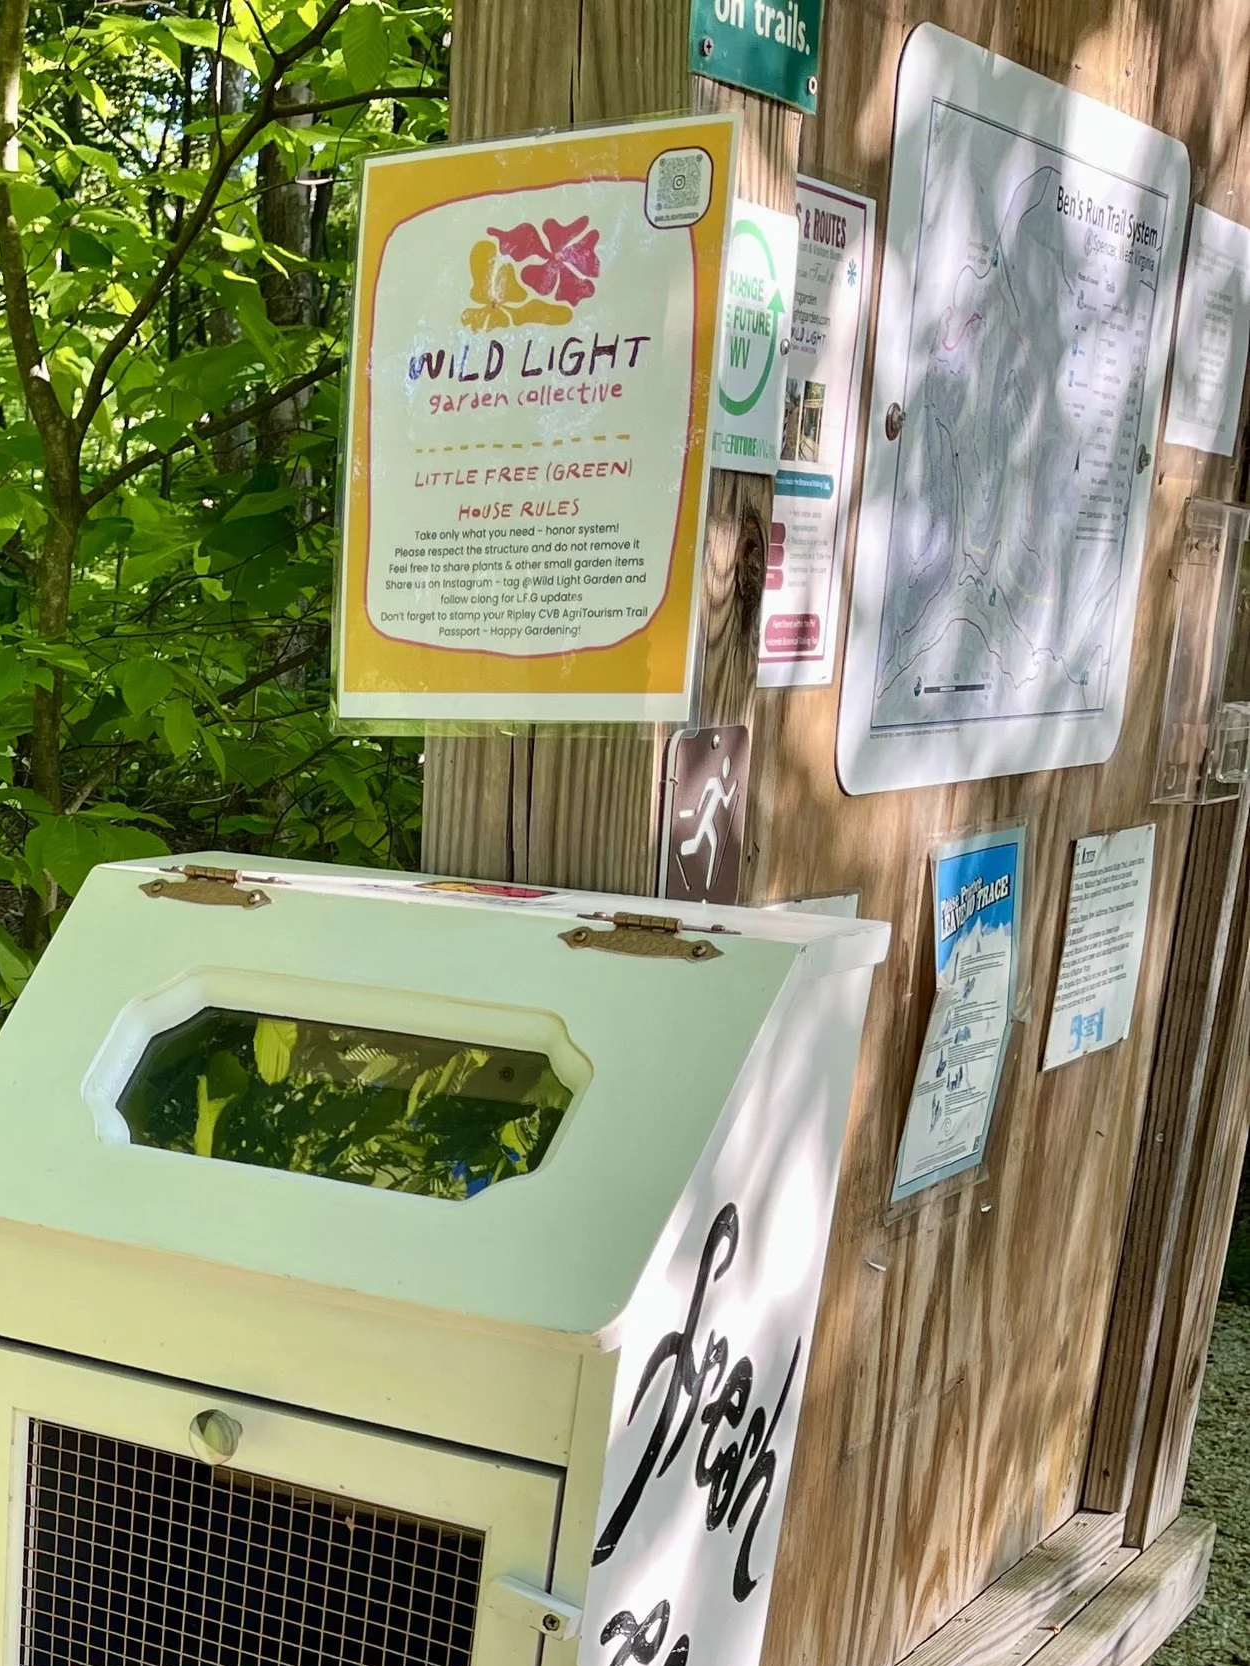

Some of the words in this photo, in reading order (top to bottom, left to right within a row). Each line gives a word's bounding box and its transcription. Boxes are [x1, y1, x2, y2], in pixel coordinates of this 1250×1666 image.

[754, 0, 810, 56] trails.
[813, 207, 847, 250] ROUTES
[1056, 185, 1084, 221] Ben's
[1085, 196, 1105, 228] Run
[1106, 204, 1128, 236] Trail
[1127, 213, 1158, 248] System
[733, 305, 772, 337] FUTURE
[408, 339, 504, 382] WILD
[520, 332, 651, 378] LIGHT
[730, 335, 751, 370] WV
[429, 391, 509, 415] garden
[517, 380, 623, 406] collective
[415, 468, 478, 488] LITTLE
[485, 466, 539, 485] FREE
[546, 457, 633, 482] (GREEN)
[458, 503, 513, 521] HOUSE
[520, 498, 580, 518] RULES
[414, 529, 437, 541] Take
[439, 529, 460, 541] only
[462, 528, 487, 539] what
[488, 529, 507, 541] you
[509, 526, 535, 537] need
[545, 525, 575, 535] honor
[578, 523, 620, 537] system!
[394, 547, 425, 557] Please
[428, 545, 464, 558] respect
[466, 545, 482, 555] the
[485, 543, 529, 554] structure
[531, 542, 552, 553] and
[554, 541, 568, 552] do
[570, 541, 588, 551] not
[590, 540, 631, 551] remove
[633, 538, 640, 549] it
[388, 563, 408, 573] Feel
[410, 562, 428, 573] free
[431, 562, 441, 572] to
[443, 562, 470, 572] share
[472, 561, 503, 573] plants
[504, 560, 512, 571] &
[514, 559, 541, 570] other
[544, 558, 572, 569] small
[574, 557, 612, 571] garden
[614, 556, 644, 567] items
[385, 579, 412, 590] Share
[414, 580, 426, 589] us
[428, 580, 441, 589] on
[443, 578, 492, 590] Instagram
[503, 577, 519, 590] tag
[522, 575, 555, 588] @Wild
[556, 575, 581, 588] Light
[583, 573, 623, 585] Garden
[625, 572, 646, 584] and
[440, 594, 468, 604] follow
[470, 593, 499, 607] along
[501, 593, 515, 603] for
[540, 591, 583, 605] updates
[380, 611, 405, 621] Don't
[407, 611, 435, 624] forget
[437, 611, 447, 621] to
[449, 611, 481, 623] stamp
[483, 611, 505, 623] your
[507, 609, 536, 623] Ripley
[538, 608, 560, 619] CVB
[562, 607, 623, 621] AgriTourism
[626, 606, 648, 617] Trail
[438, 626, 480, 639] Passport
[490, 625, 522, 638] Happy
[524, 624, 581, 638] Gardening!
[976, 873, 1010, 912] TRACE
